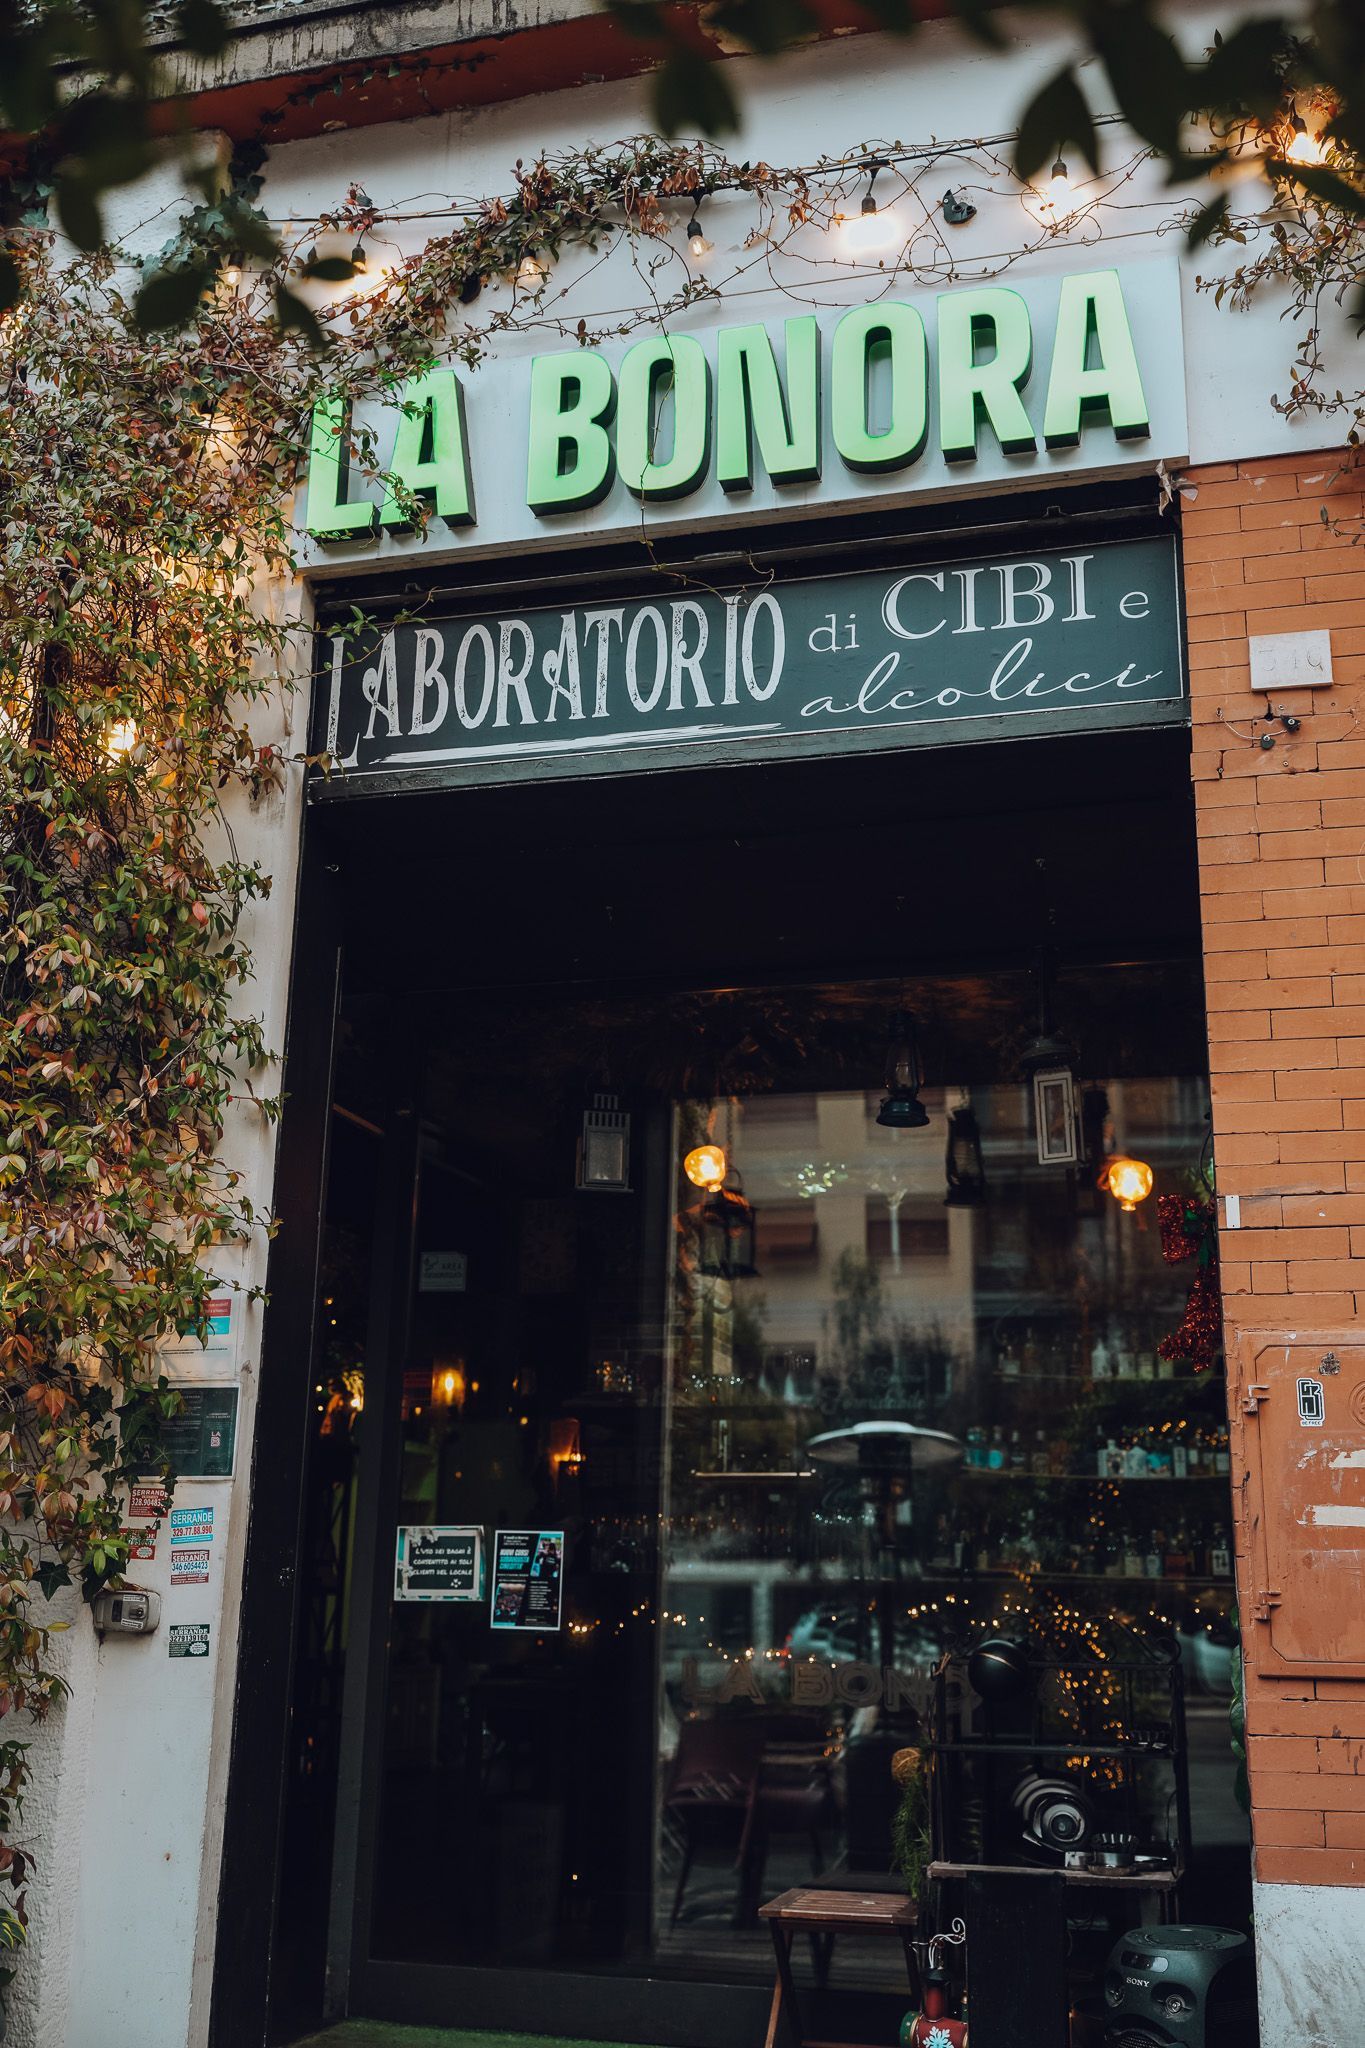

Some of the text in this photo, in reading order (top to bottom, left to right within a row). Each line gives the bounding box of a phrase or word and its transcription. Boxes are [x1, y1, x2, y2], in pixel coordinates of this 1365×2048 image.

[305, 269, 1150, 540] LA BONORA
[327, 556, 1150, 769] LABORATORIO di CIBI e
[800, 637, 1162, 719] alcolici
[172, 1512, 213, 1525] SERRANDE
[172, 1554, 209, 1562] SERRANDE
[682, 1659, 767, 1705] LA
[1126, 1977, 1150, 1988] SONY
